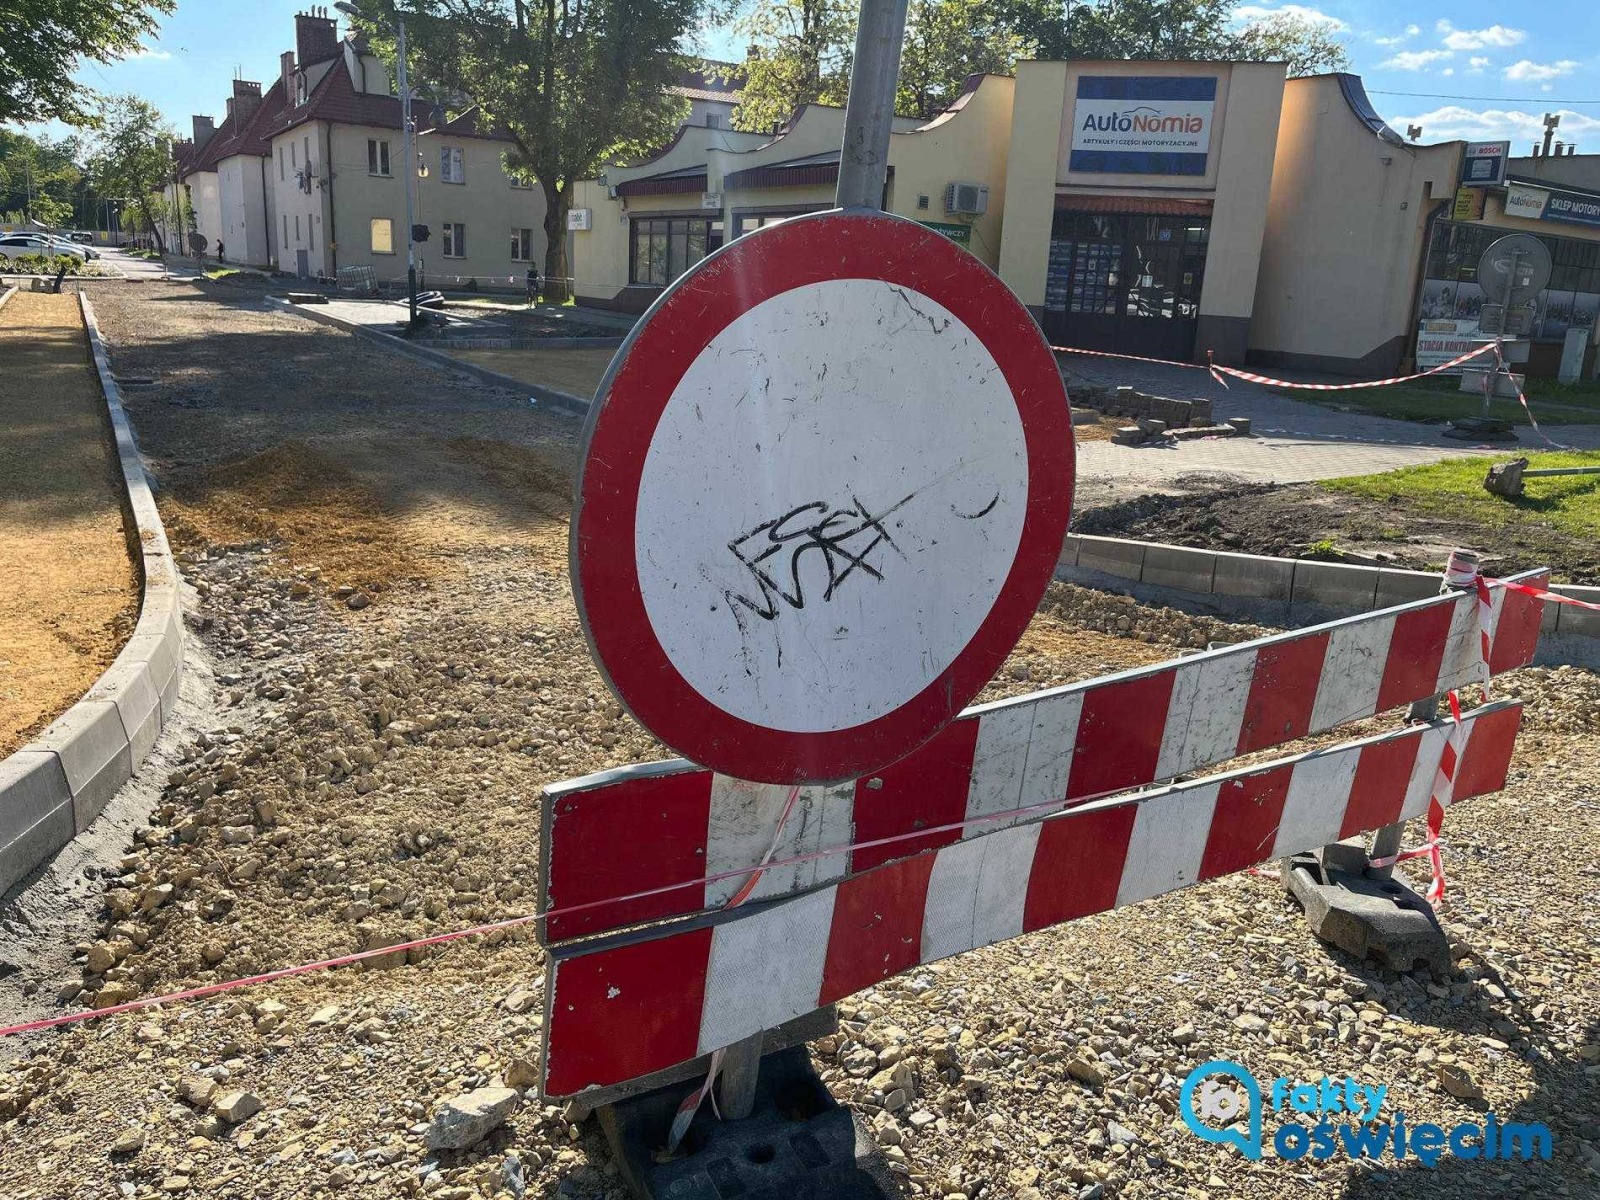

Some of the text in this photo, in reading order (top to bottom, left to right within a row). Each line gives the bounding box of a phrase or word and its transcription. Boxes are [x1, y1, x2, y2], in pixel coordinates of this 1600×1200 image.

[1118, 138, 1141, 147] CZĘŚCI
[1551, 198, 1571, 211] SKLEP
[936, 227, 965, 237] ŻYWCZY
[1418, 340, 1443, 351] STACJA
